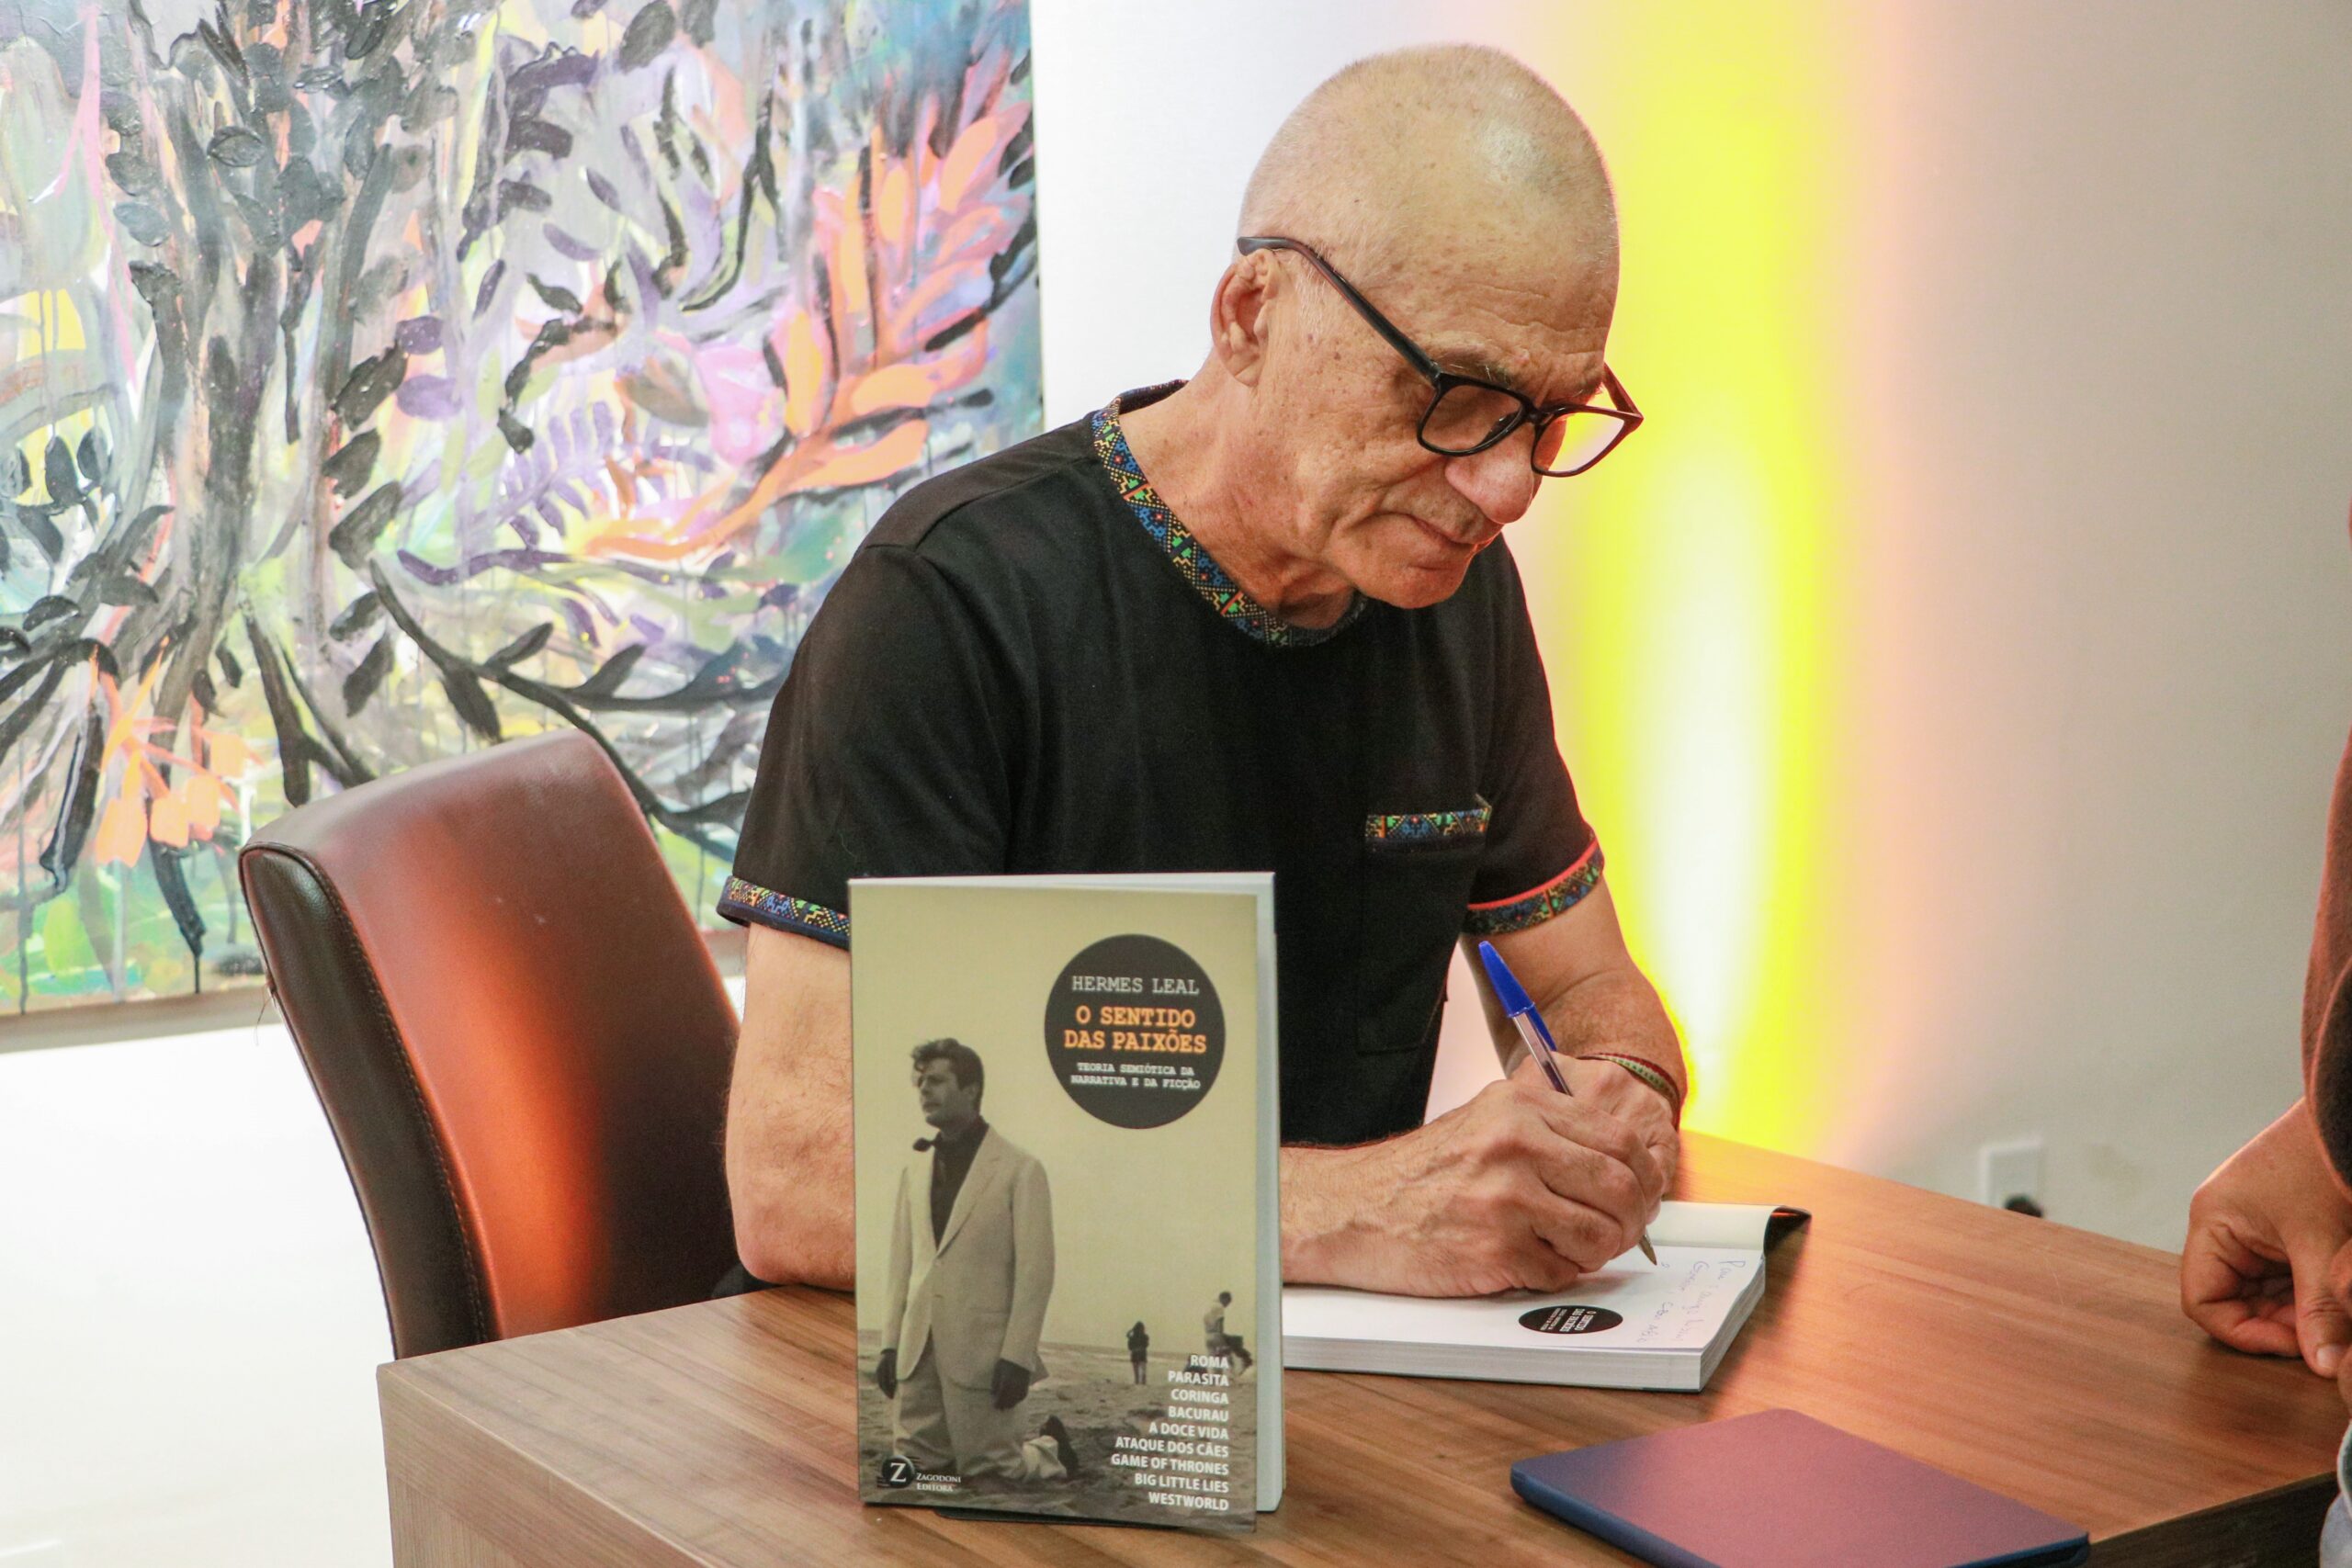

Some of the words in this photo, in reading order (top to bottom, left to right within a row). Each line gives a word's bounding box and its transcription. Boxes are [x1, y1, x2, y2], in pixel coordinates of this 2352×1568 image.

[1072, 976, 1143, 993] HERMES
[1152, 977, 1200, 995] LEAL
[1075, 1005, 1091, 1024] O
[1100, 1006, 1196, 1029] SENTIDO
[1064, 1030, 1105, 1049] DAS
[1112, 1029, 1206, 1054] PAIXÕES
[1077, 1062, 1115, 1073] TEORIA
[1119, 1063, 1176, 1076] SEMIÓTICA
[1181, 1066, 1194, 1076] DA
[1070, 1075, 1127, 1086] NARRATIVA
[1144, 1078, 1158, 1088] DA
[1162, 1078, 1201, 1090] FICÇÃO
[1190, 1354, 1229, 1369] ROMA
[1168, 1371, 1229, 1386] PARASITA
[1170, 1388, 1228, 1404] CORINGA
[1168, 1405, 1228, 1421] BACURAU
[1148, 1422, 1159, 1434] A
[1160, 1423, 1195, 1437] DOCE
[1197, 1426, 1229, 1440] VIDA
[1115, 1437, 1164, 1452] ATAQUE
[1167, 1440, 1193, 1454] DOS
[1196, 1441, 1228, 1458] CÃES
[889, 1462, 907, 1483] Z
[1111, 1453, 1148, 1468] GAME
[1150, 1457, 1168, 1469] OF
[1170, 1459, 1229, 1475] THRONES
[1135, 1472, 1156, 1486] BIG
[1159, 1474, 1200, 1490] LITTLE
[1203, 1480, 1229, 1493] LIES
[1148, 1491, 1229, 1511] WESTWORLD
